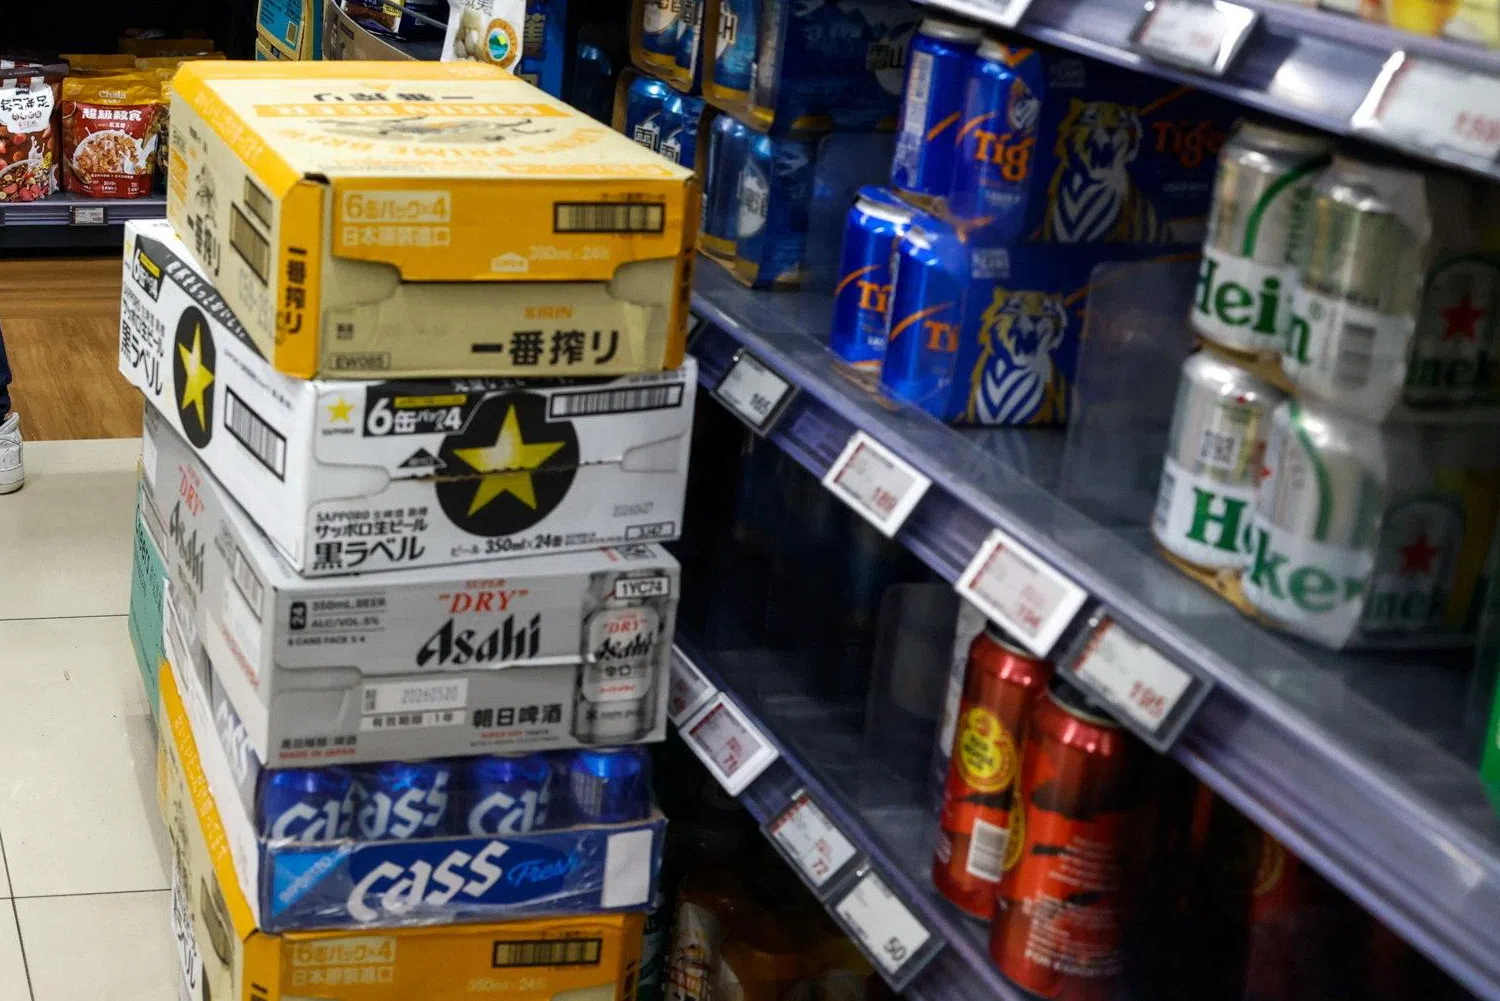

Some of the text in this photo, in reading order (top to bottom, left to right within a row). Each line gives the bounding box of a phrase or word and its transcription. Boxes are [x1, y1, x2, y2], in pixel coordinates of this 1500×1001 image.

[471, 329, 619, 366] 一番搾り
[315, 519, 429, 538] サッポロ生ビール
[317, 511, 370, 522] SAPPORO
[314, 536, 426, 569] 黒ラベル
[620, 581, 663, 596] 1YC74
[415, 612, 542, 667] Asahi
[471, 703, 563, 728] 朝日啤酒
[882, 936, 908, 962] 50
